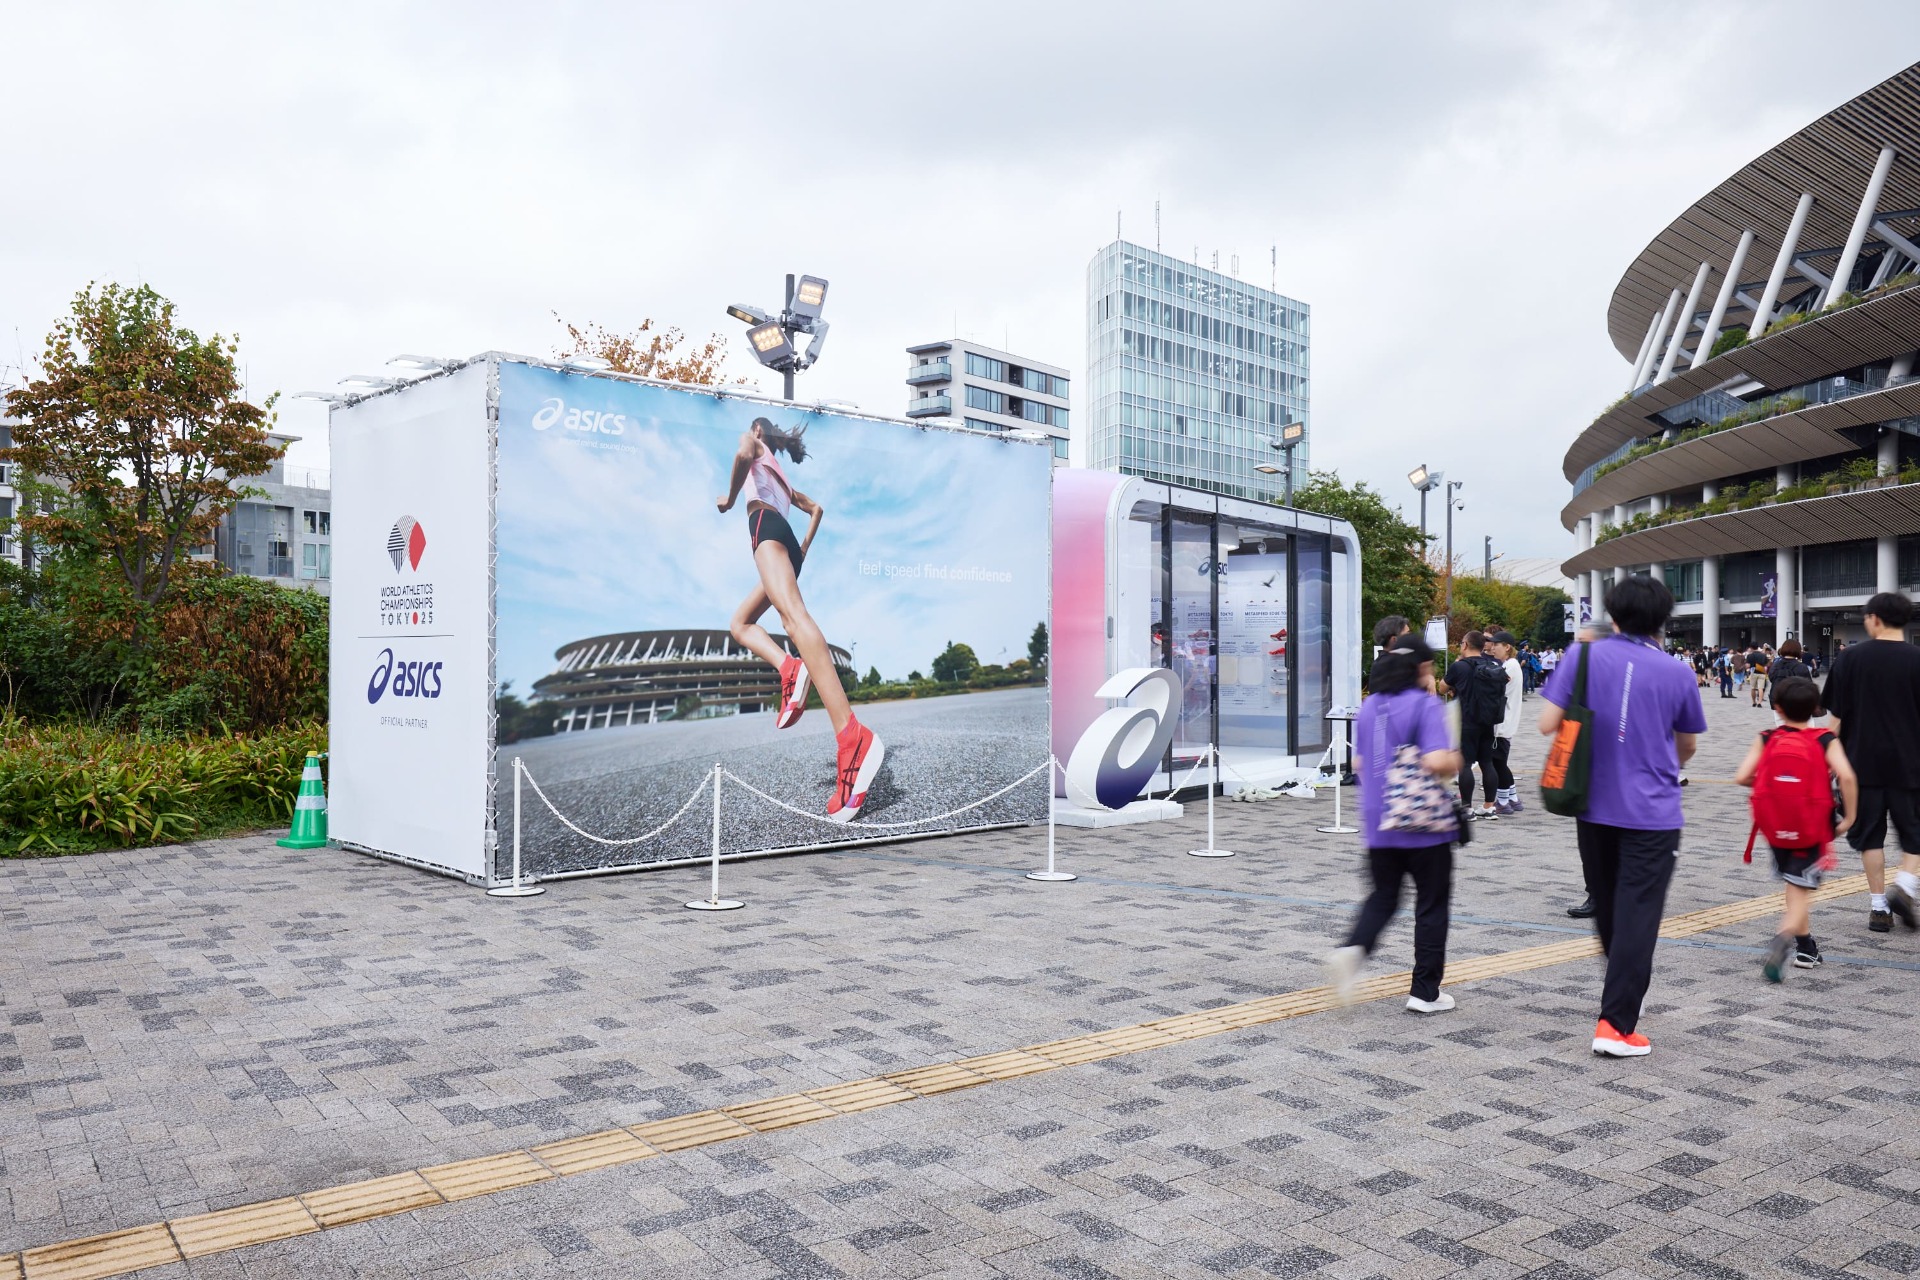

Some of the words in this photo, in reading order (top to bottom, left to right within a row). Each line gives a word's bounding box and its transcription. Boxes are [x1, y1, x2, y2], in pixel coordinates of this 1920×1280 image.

[564, 408, 626, 435] asics
[858, 560, 881, 576] feel
[884, 563, 920, 580] speed
[924, 564, 947, 579] find
[950, 567, 1012, 583] confidence
[381, 586, 402, 597] WORLD
[402, 584, 433, 596] ATHLETICS
[381, 597, 433, 610] CHAMPIONSHIPS
[1822, 627, 1831, 636] D2
[393, 662, 442, 698] asics
[380, 716, 404, 726] OFFICIAL
[405, 718, 428, 729] PARTNER
